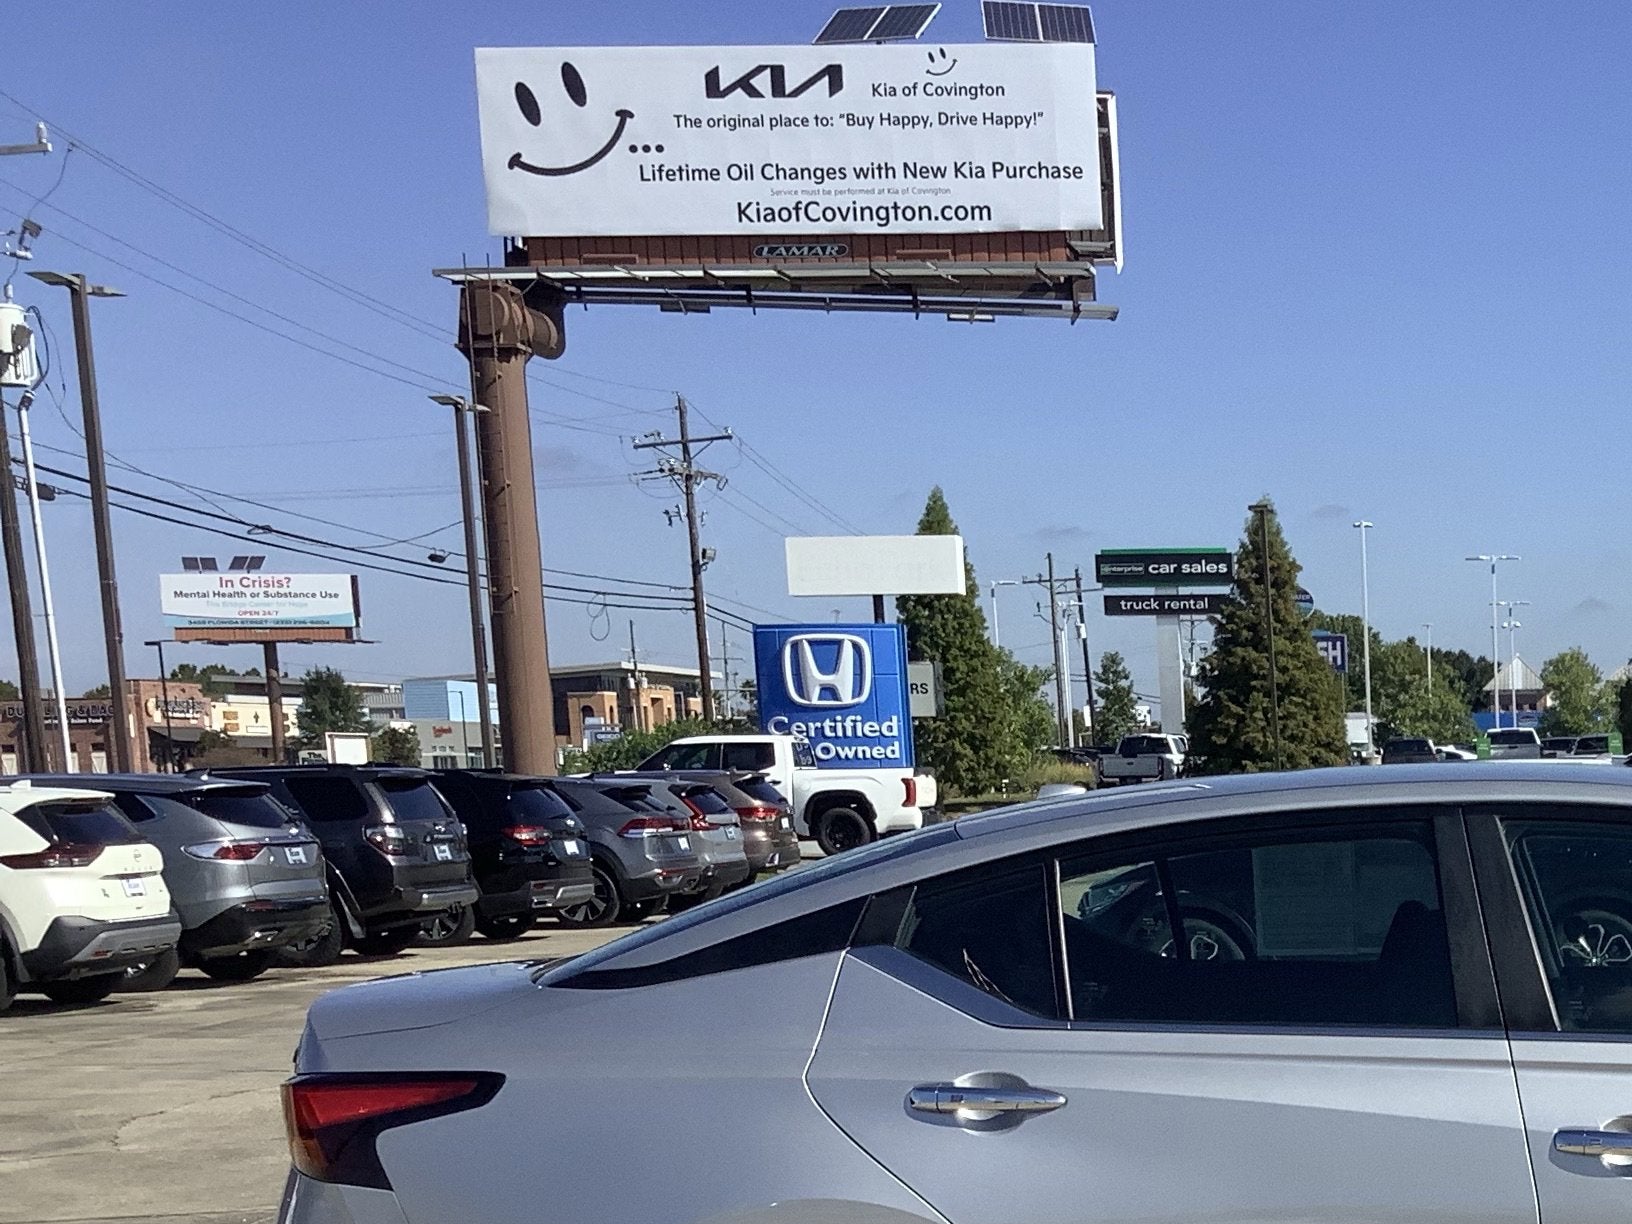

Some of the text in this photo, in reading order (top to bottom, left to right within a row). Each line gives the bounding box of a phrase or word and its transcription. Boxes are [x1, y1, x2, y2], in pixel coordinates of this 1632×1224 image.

[704, 63, 844, 99] KIA
[871, 81, 1006, 100] Kia of Covington
[673, 114, 702, 129] The
[706, 113, 765, 132] original
[769, 113, 810, 131] place
[815, 115, 834, 128] to:
[879, 111, 934, 130] Happy,
[938, 111, 978, 126] Drive
[639, 160, 1084, 185] Lifetime Oil Changes with New Kia Purchase
[822, 187, 833, 196] be
[834, 186, 875, 198] performed
[877, 187, 886, 195] at
[887, 186, 900, 195] Kia
[901, 186, 910, 195] of
[911, 186, 952, 198] Covington
[736, 200, 993, 228] KiaofCovington.com
[761, 245, 840, 258] LAMAR
[1148, 562, 1178, 574] car
[1181, 559, 1228, 574] sales
[218, 576, 292, 589] In Crisis?
[173, 590, 340, 599] Mental Health or Substance Use
[1119, 597, 1209, 610] truck rental
[767, 715, 899, 737] Certified
[812, 740, 900, 760] Owned
